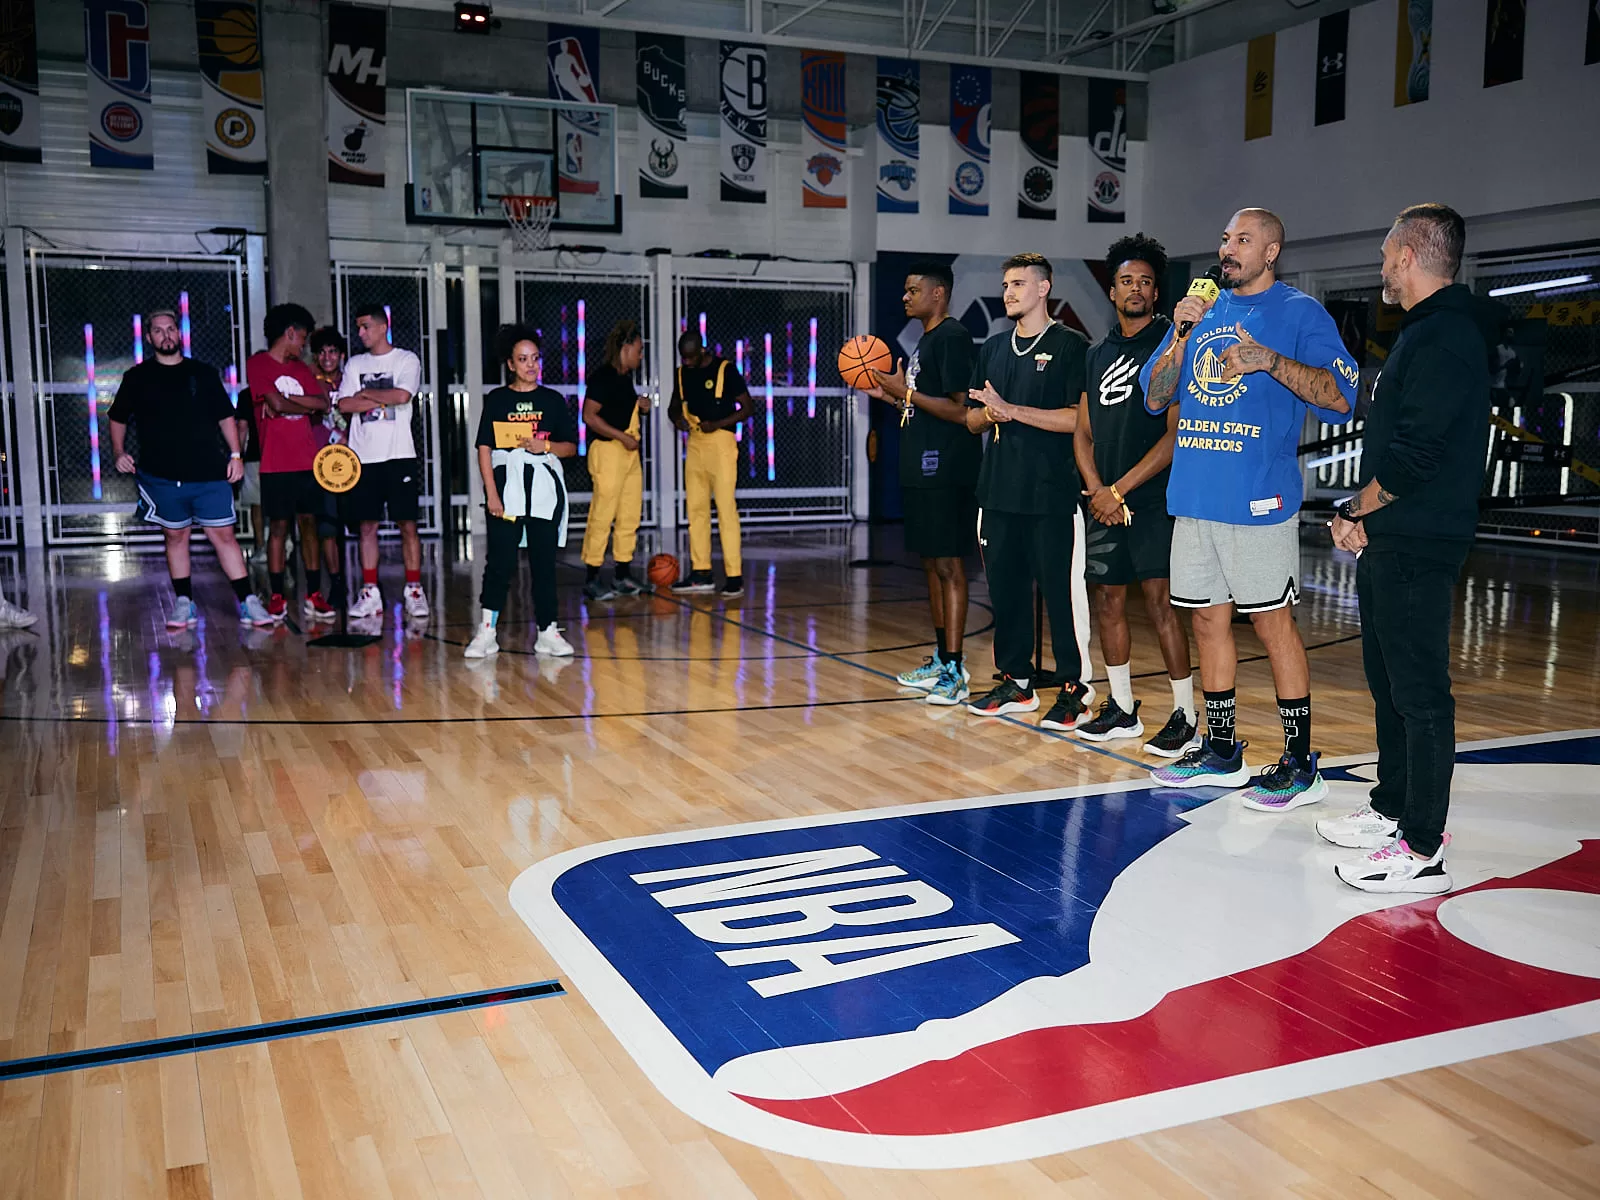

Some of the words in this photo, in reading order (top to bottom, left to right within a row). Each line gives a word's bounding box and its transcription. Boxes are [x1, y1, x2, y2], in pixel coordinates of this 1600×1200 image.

[643, 61, 686, 102] BUCKS
[747, 54, 767, 110] B
[1196, 326, 1235, 344] GOLDEN
[1187, 380, 1248, 407] WARRIORS
[516, 402, 533, 411] ON
[507, 411, 543, 421] COURT
[1222, 421, 1262, 438] STATE
[1178, 436, 1244, 453] WARRIORS
[1205, 697, 1236, 709] CEND
[1278, 706, 1309, 717] ENTS
[629, 844, 1022, 999] NBA
